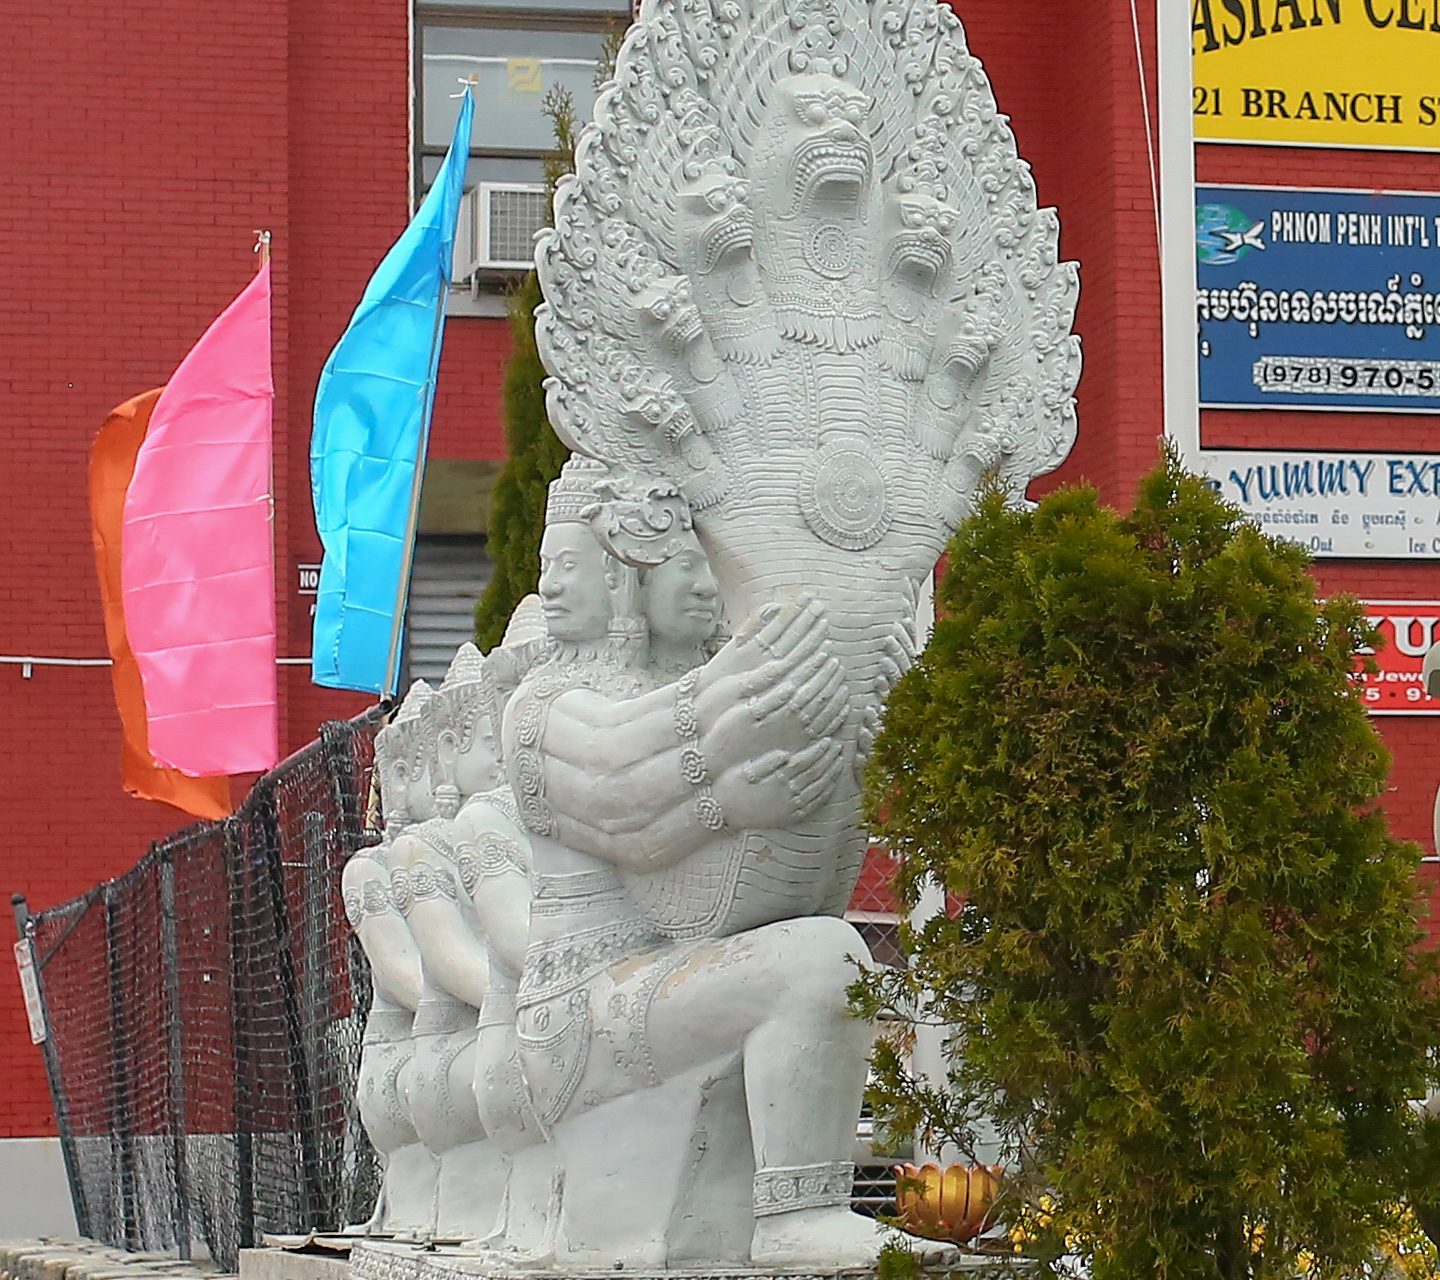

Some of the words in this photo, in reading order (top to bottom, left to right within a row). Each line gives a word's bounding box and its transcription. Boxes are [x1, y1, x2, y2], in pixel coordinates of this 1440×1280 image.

[1241, 88, 1402, 124] BRANCH
[1271, 211, 1331, 244] PHNOM
[1337, 214, 1382, 246] PENH
[1387, 215, 1430, 248] INT'L
[1262, 364, 1331, 385] (978)
[1229, 459, 1374, 503] YUMMY
[1409, 537, 1426, 553] Ice
